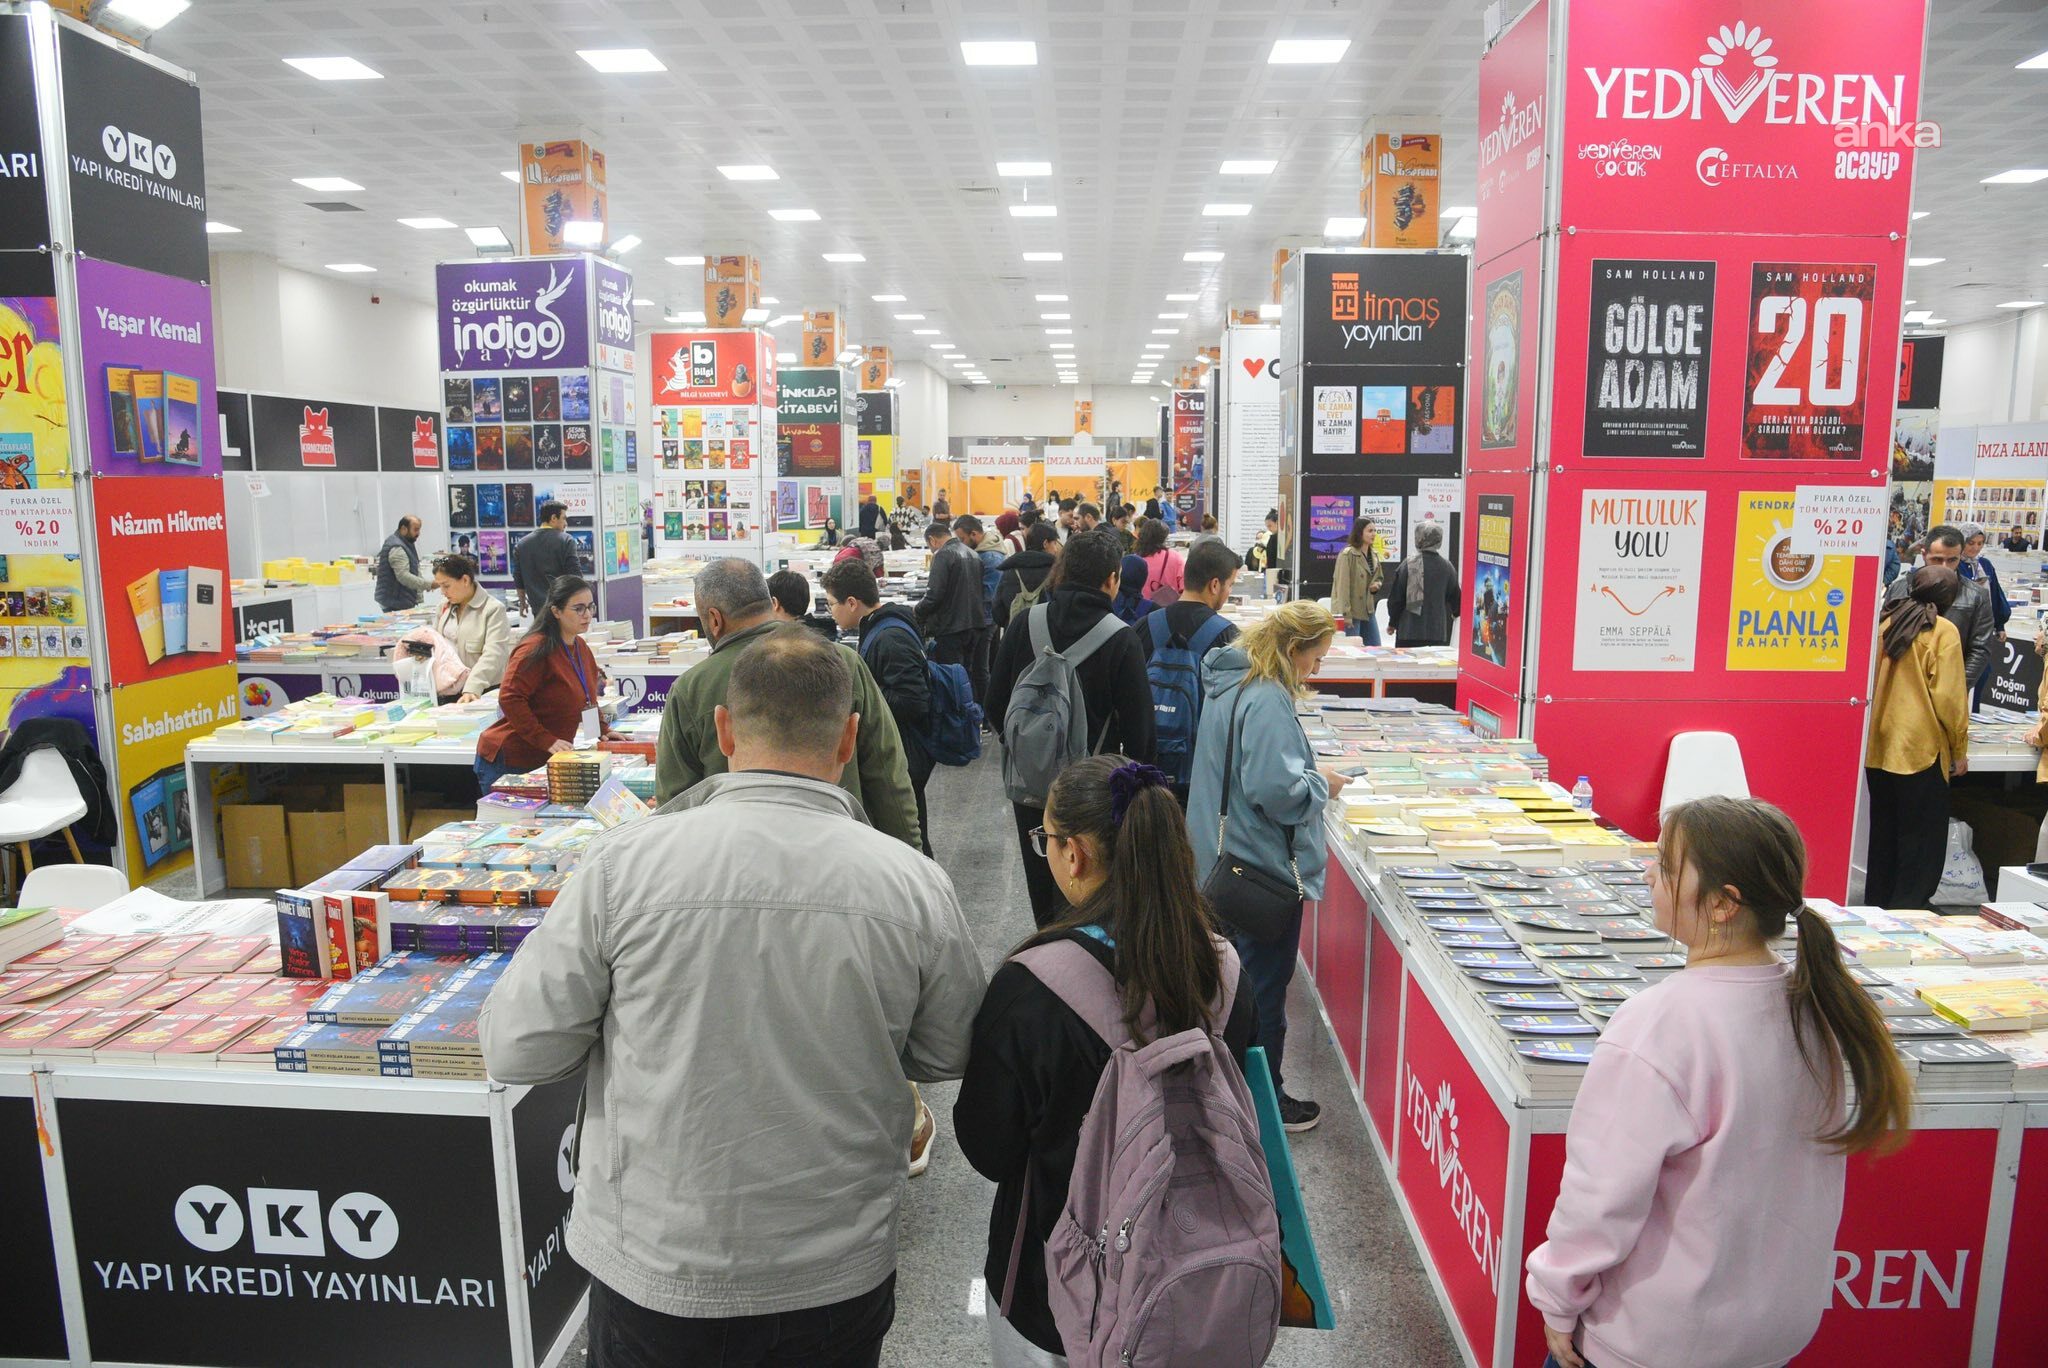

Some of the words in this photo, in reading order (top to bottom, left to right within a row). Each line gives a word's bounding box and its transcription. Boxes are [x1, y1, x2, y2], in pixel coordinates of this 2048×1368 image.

[1584, 67, 1905, 125] YEDİVEREN
[1480, 95, 1542, 168] YEDİVEREN
[105, 130, 174, 175] YKY
[1835, 151, 1899, 180] acayip
[72, 155, 102, 179] YAPI
[106, 166, 143, 192] KREDİ
[146, 180, 204, 211] YAYINLARI
[464, 279, 516, 293] okumak
[1606, 270, 1633, 280] SAM
[1643, 270, 1705, 281] HOLLAND
[1766, 272, 1792, 282] SAM
[1804, 272, 1864, 284] HOLLAND
[452, 298, 530, 314] özgürlüktür
[1364, 290, 1440, 328] timaş
[96, 306, 144, 338] Yaşar
[150, 316, 200, 344] Kemal
[454, 316, 560, 359] indigo
[1604, 296, 1704, 355] GÖLGE
[1752, 296, 1863, 406] 20
[694, 368, 713, 377] Bilgi
[1598, 360, 1698, 409] ADAM
[782, 385, 837, 398] İNKILÂP
[1977, 441, 2008, 458] İMZA
[1800, 506, 1818, 514] TÜM
[1823, 506, 1880, 514] KİTAPLARDA
[1848, 494, 1872, 502] ÖZEL
[21, 508, 72, 516] KİTAPLARDA
[111, 512, 163, 536] Nâzım
[168, 510, 223, 532] Hikmet
[1591, 498, 1697, 526] MUTLULUK
[16, 520, 59, 536] %20
[1814, 518, 1863, 534] %20
[1614, 530, 1668, 558] YOLU
[1820, 540, 1858, 548] İNDİRİM
[1591, 584, 1597, 592] A
[1679, 586, 1685, 594] B
[1600, 627, 1623, 636] EMMA
[1738, 610, 1839, 636] PLANLA
[1737, 637, 1788, 648] RAHAT
[1800, 637, 1839, 650] YAŞA
[1992, 688, 2029, 706] Yayınları
[1996, 676, 2026, 692] Doğan
[122, 704, 213, 746] Sabahattin
[217, 695, 236, 718] Ali
[1407, 1062, 1501, 1297] YEDİVEREN
[180, 1192, 392, 1252] YKY
[528, 1226, 560, 1288] YAPI
[94, 1261, 174, 1291] YAPI
[186, 1263, 294, 1298] KREDİ
[303, 1270, 495, 1308] YAYINLARI
[1824, 1250, 1970, 1309] REN
